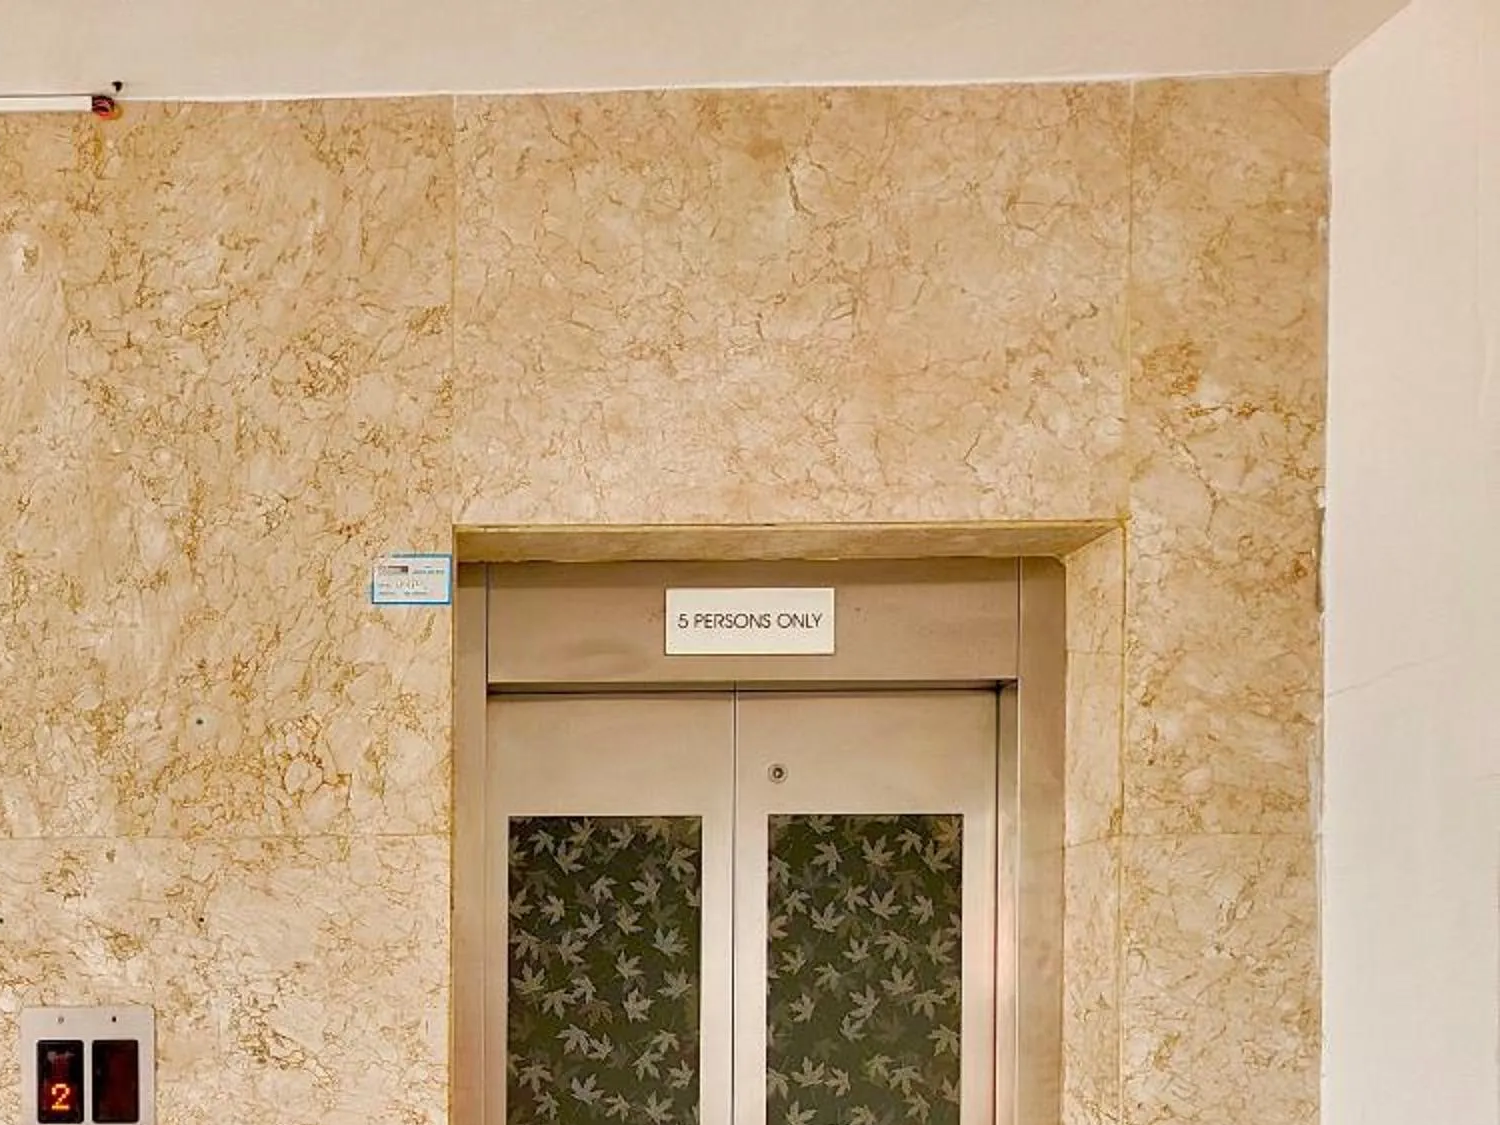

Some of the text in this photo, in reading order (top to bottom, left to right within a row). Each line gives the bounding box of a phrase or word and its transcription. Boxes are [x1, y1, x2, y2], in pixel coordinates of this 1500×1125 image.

[677, 613, 823, 629] 5 PERSONS ONLY
[51, 1083, 71, 1111] 2
